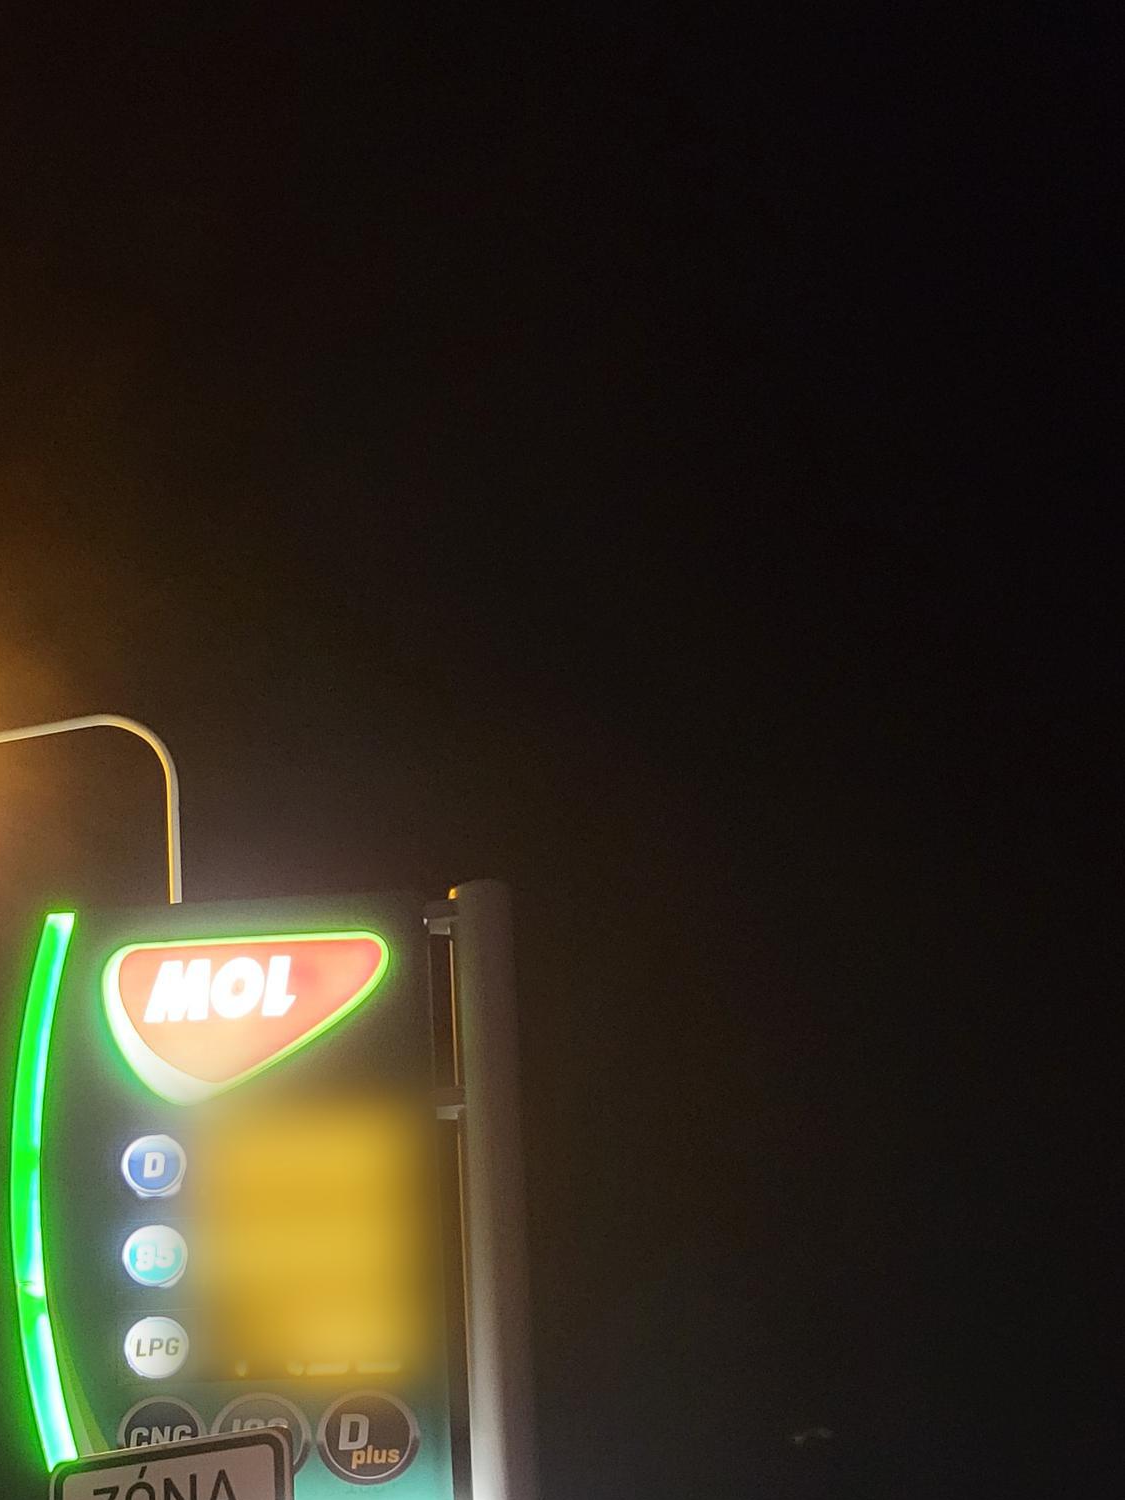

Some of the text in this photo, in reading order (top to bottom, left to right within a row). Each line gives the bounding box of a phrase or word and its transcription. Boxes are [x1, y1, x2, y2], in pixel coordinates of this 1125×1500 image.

[143, 955, 297, 1023] MOL
[143, 1151, 165, 1179] D
[135, 1337, 180, 1358] LPG
[338, 1413, 369, 1451] D
[351, 1444, 400, 1470] plus
